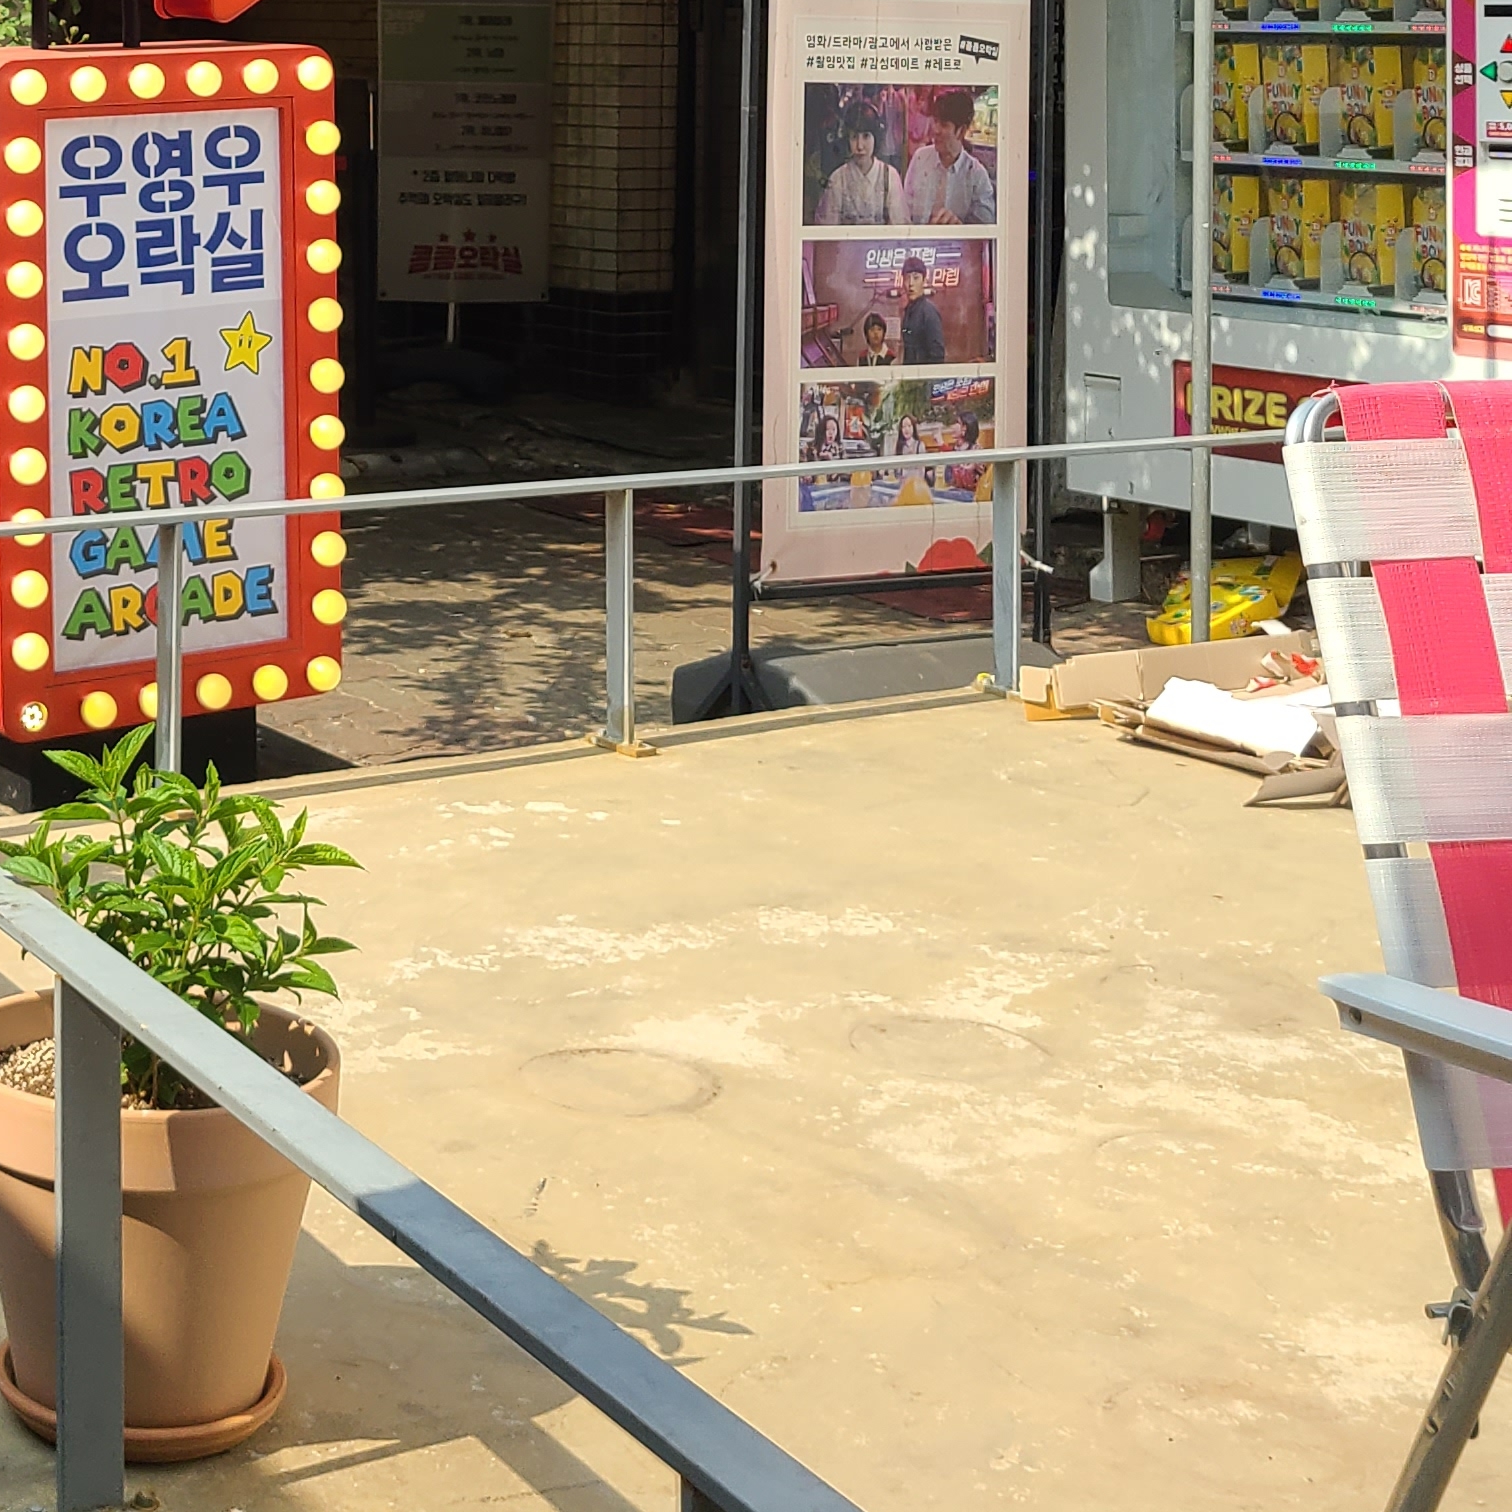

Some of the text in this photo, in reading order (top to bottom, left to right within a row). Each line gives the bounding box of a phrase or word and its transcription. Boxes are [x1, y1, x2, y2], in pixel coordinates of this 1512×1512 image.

[860, 56, 920, 71] #감성데이트
[924, 57, 962, 72] #레트로
[913, 37, 953, 52] 사랑받은
[59, 124, 265, 218] 우영우
[62, 208, 265, 303] 오락실
[865, 248, 906, 269] 인생은
[66, 337, 200, 399] NO.1
[67, 391, 248, 460] KOREA
[68, 451, 251, 516] RETRO
